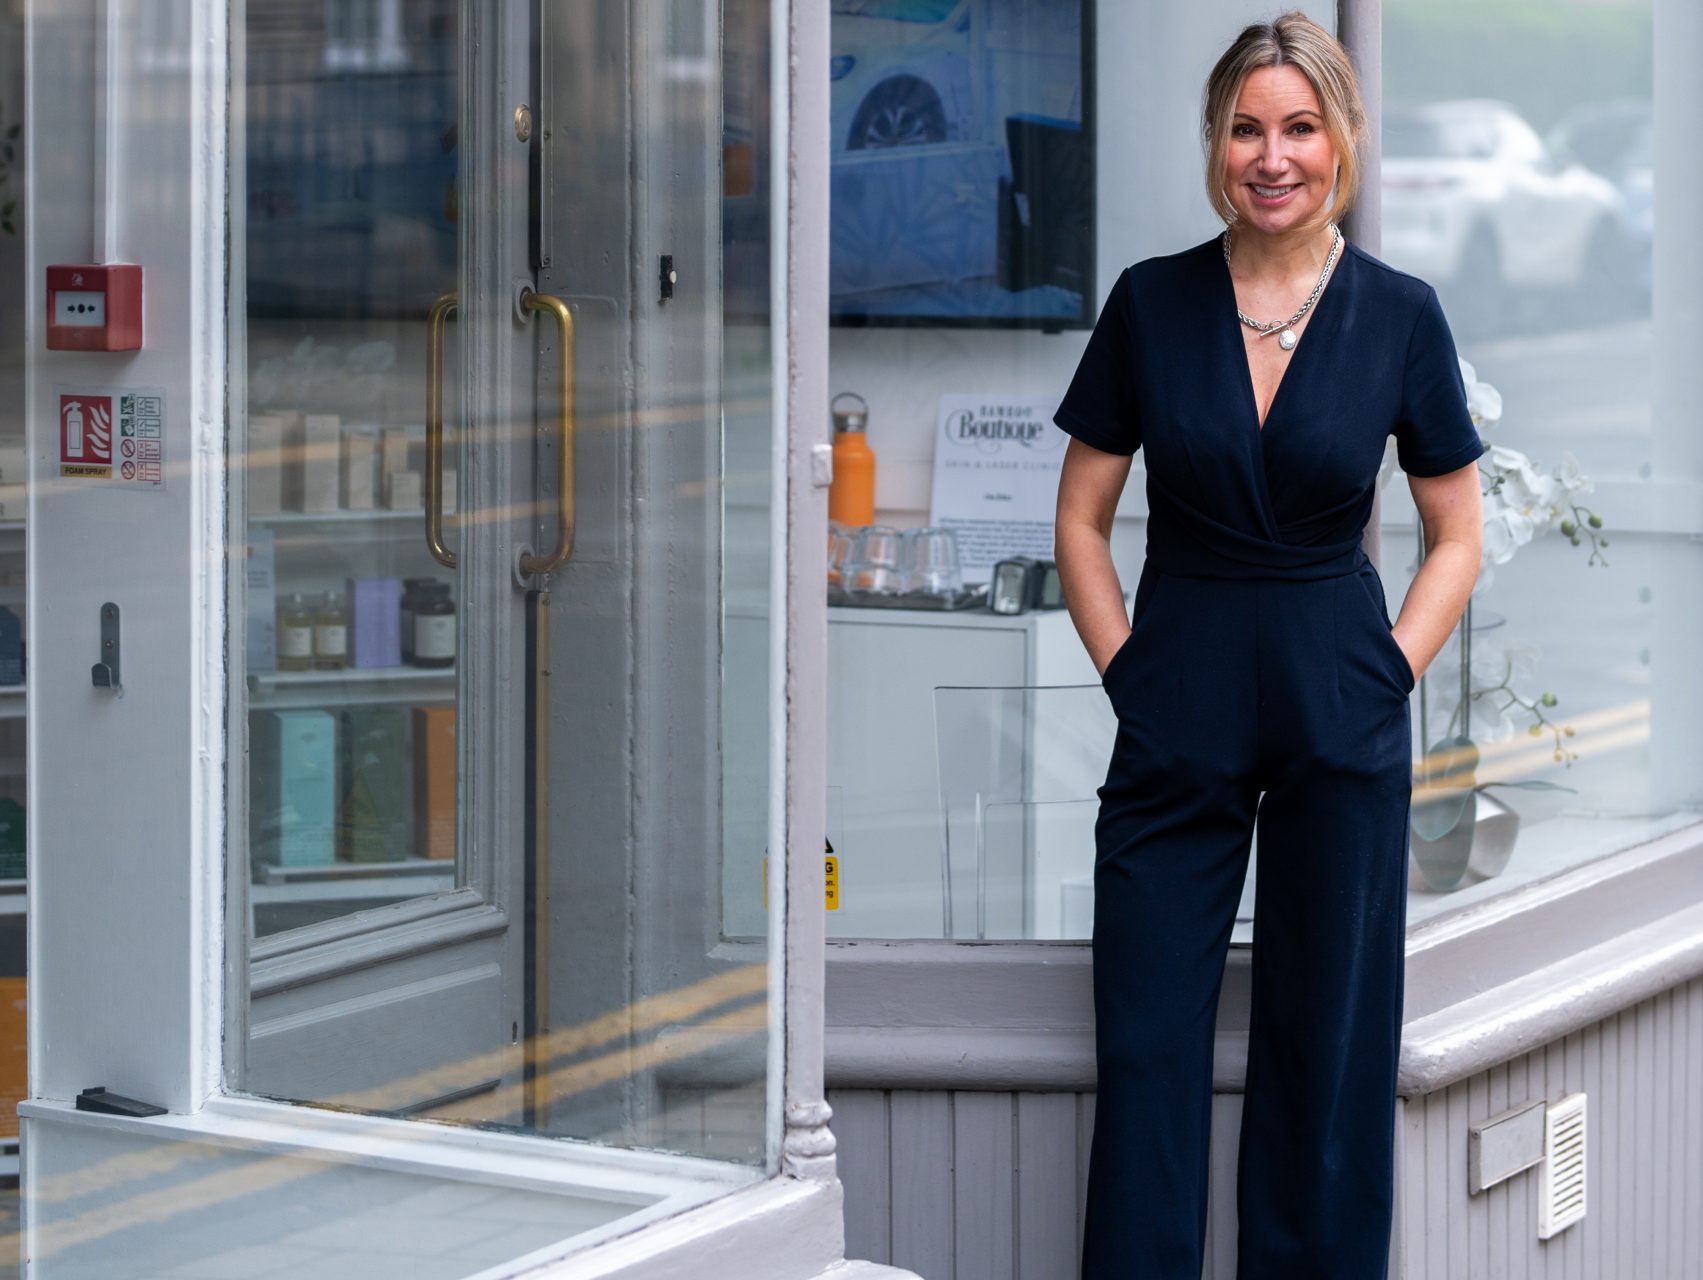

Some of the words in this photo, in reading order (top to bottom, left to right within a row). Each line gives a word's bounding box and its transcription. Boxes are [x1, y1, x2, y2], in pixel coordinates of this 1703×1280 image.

[958, 409, 1044, 448] Boutique
[65, 466, 84, 475] FOAM
[86, 467, 107, 476] SPRAY
